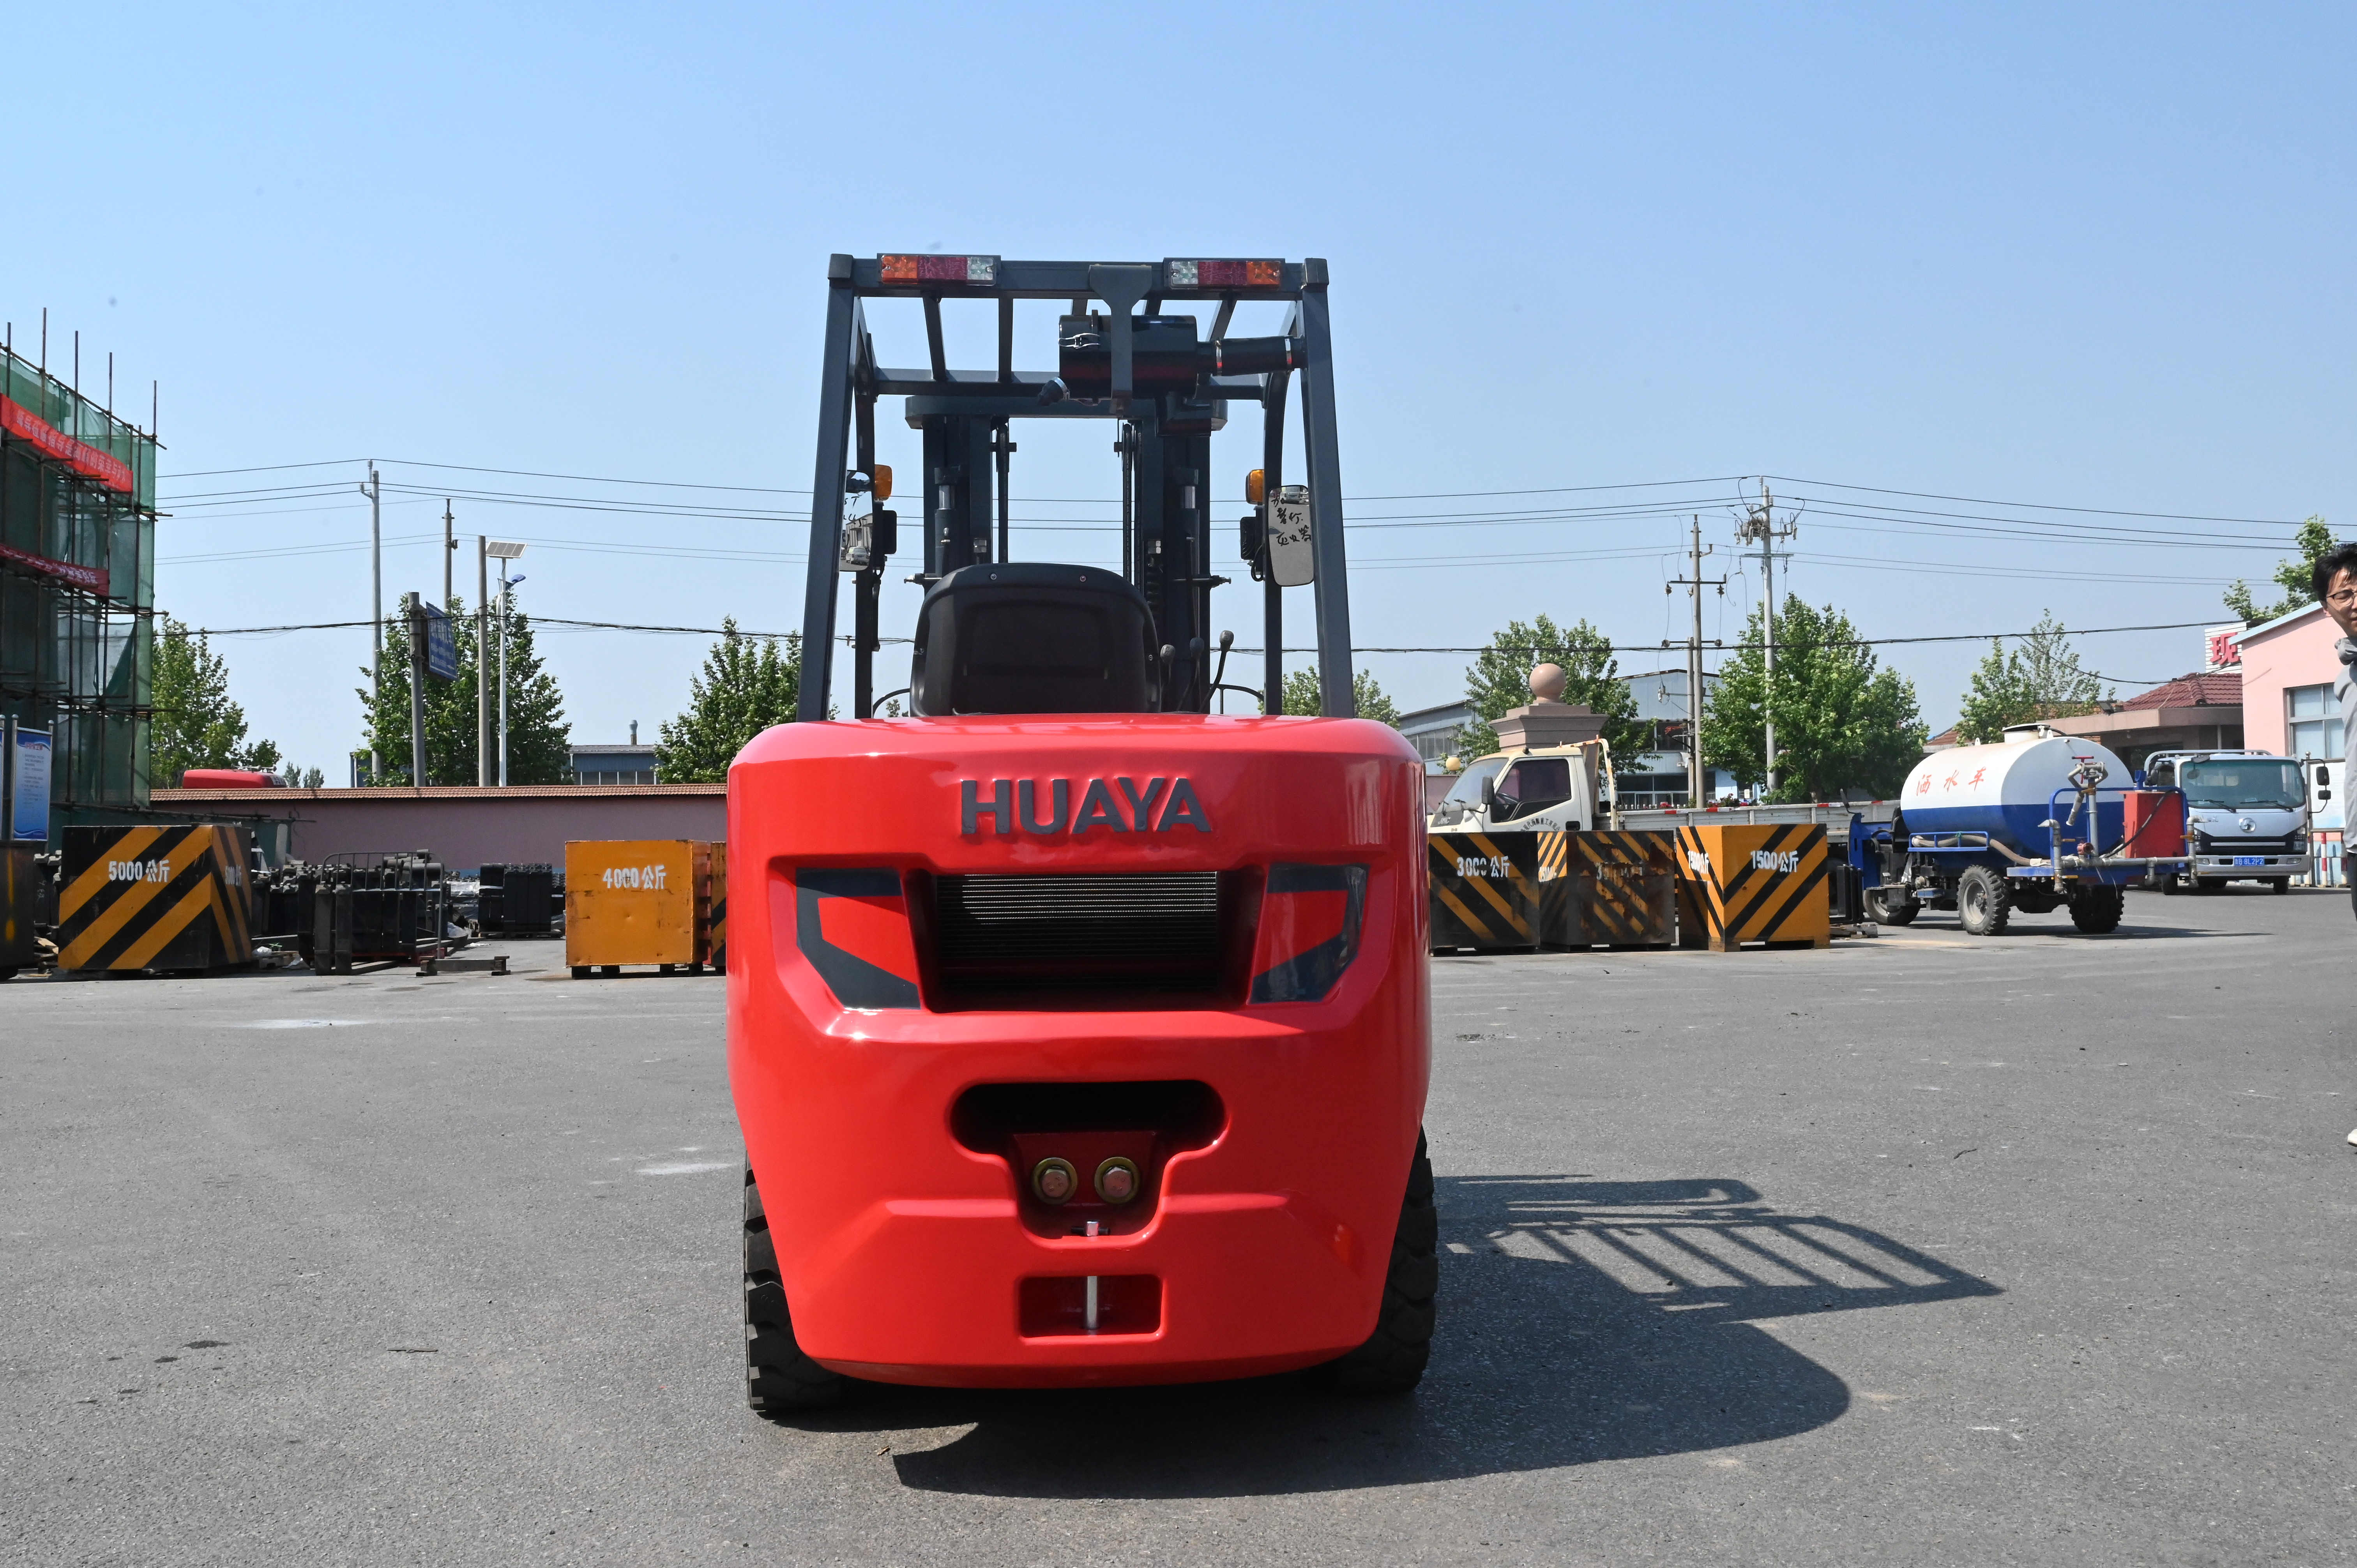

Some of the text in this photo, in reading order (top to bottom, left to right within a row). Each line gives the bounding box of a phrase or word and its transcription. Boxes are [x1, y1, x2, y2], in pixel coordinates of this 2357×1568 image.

[2210, 632, 2240, 665] 现
[1916, 766, 1986, 796] 洒水车
[960, 777, 1212, 835] HUAYA
[109, 859, 170, 883] 5000公斤
[1750, 850, 1799, 872] 1500公斤
[603, 865, 666, 889] 4000公斤
